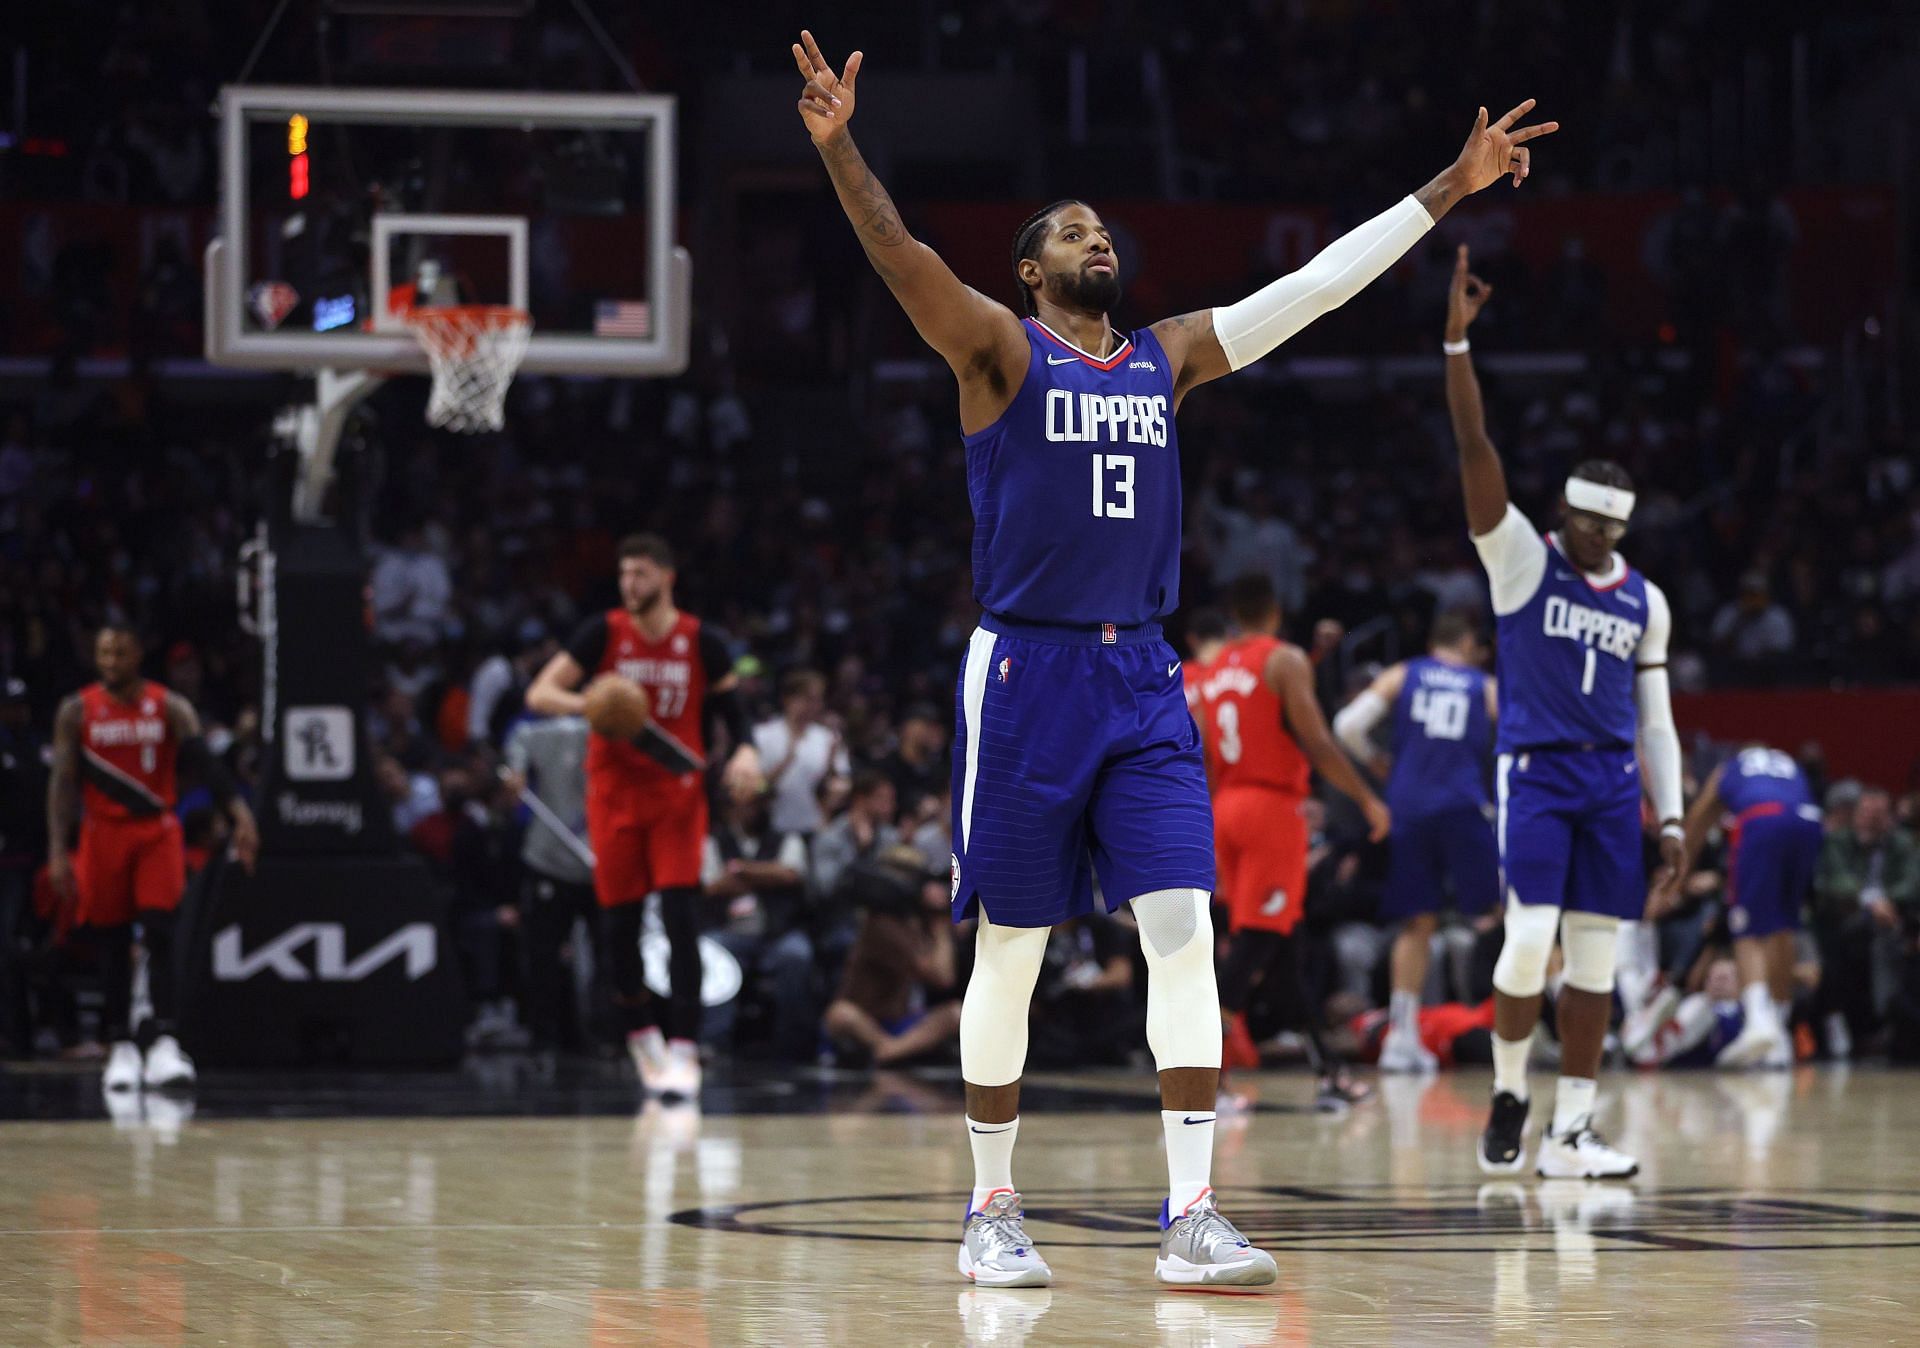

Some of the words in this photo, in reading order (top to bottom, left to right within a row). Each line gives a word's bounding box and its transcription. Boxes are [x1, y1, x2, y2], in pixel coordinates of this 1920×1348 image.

[1046, 388, 1167, 448] CLIPPERS
[1093, 454, 1135, 519] 13
[1543, 595, 1642, 662] CLIPPERS
[1581, 647, 1597, 695] 1
[1216, 700, 1241, 765] 3
[1410, 688, 1470, 740] 40
[212, 921, 438, 982] KIA
